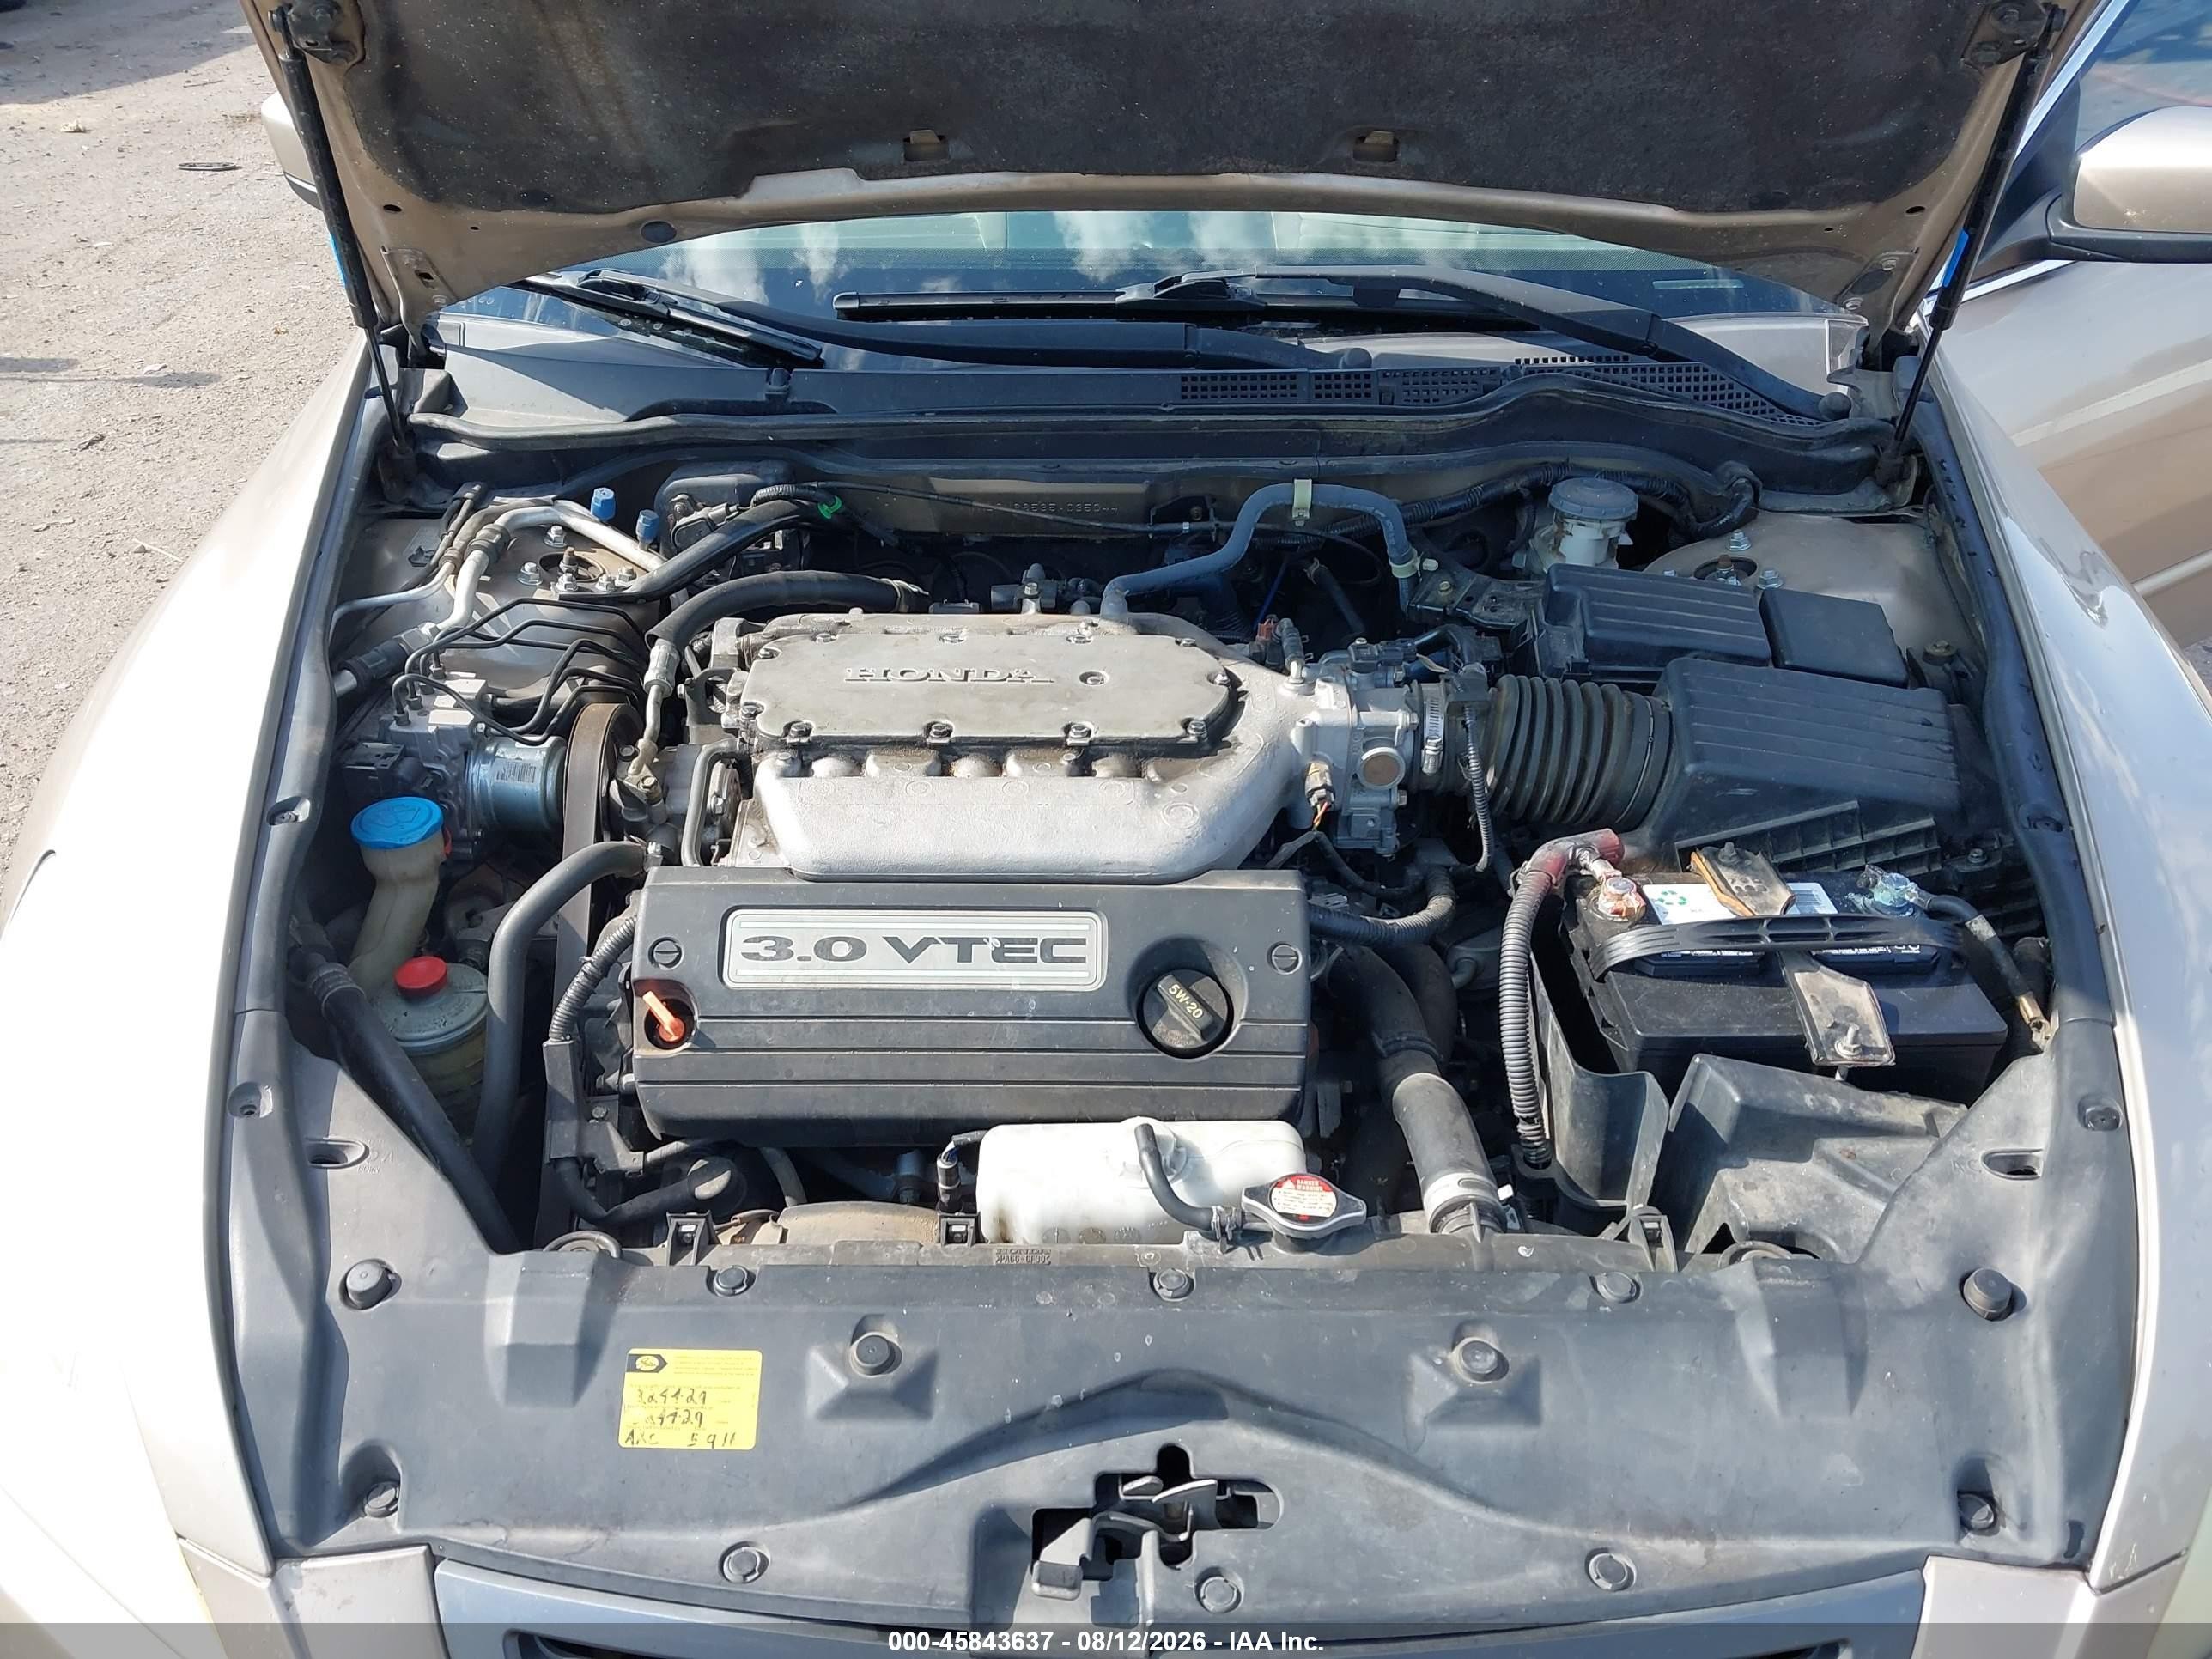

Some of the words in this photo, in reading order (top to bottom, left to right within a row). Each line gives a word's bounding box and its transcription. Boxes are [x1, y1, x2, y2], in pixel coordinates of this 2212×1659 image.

[845, 668, 1054, 684] HONDA
[740, 936, 867, 962] 3.0
[882, 936, 1086, 963] VTEC
[1169, 984, 1203, 1019] 5W-20
